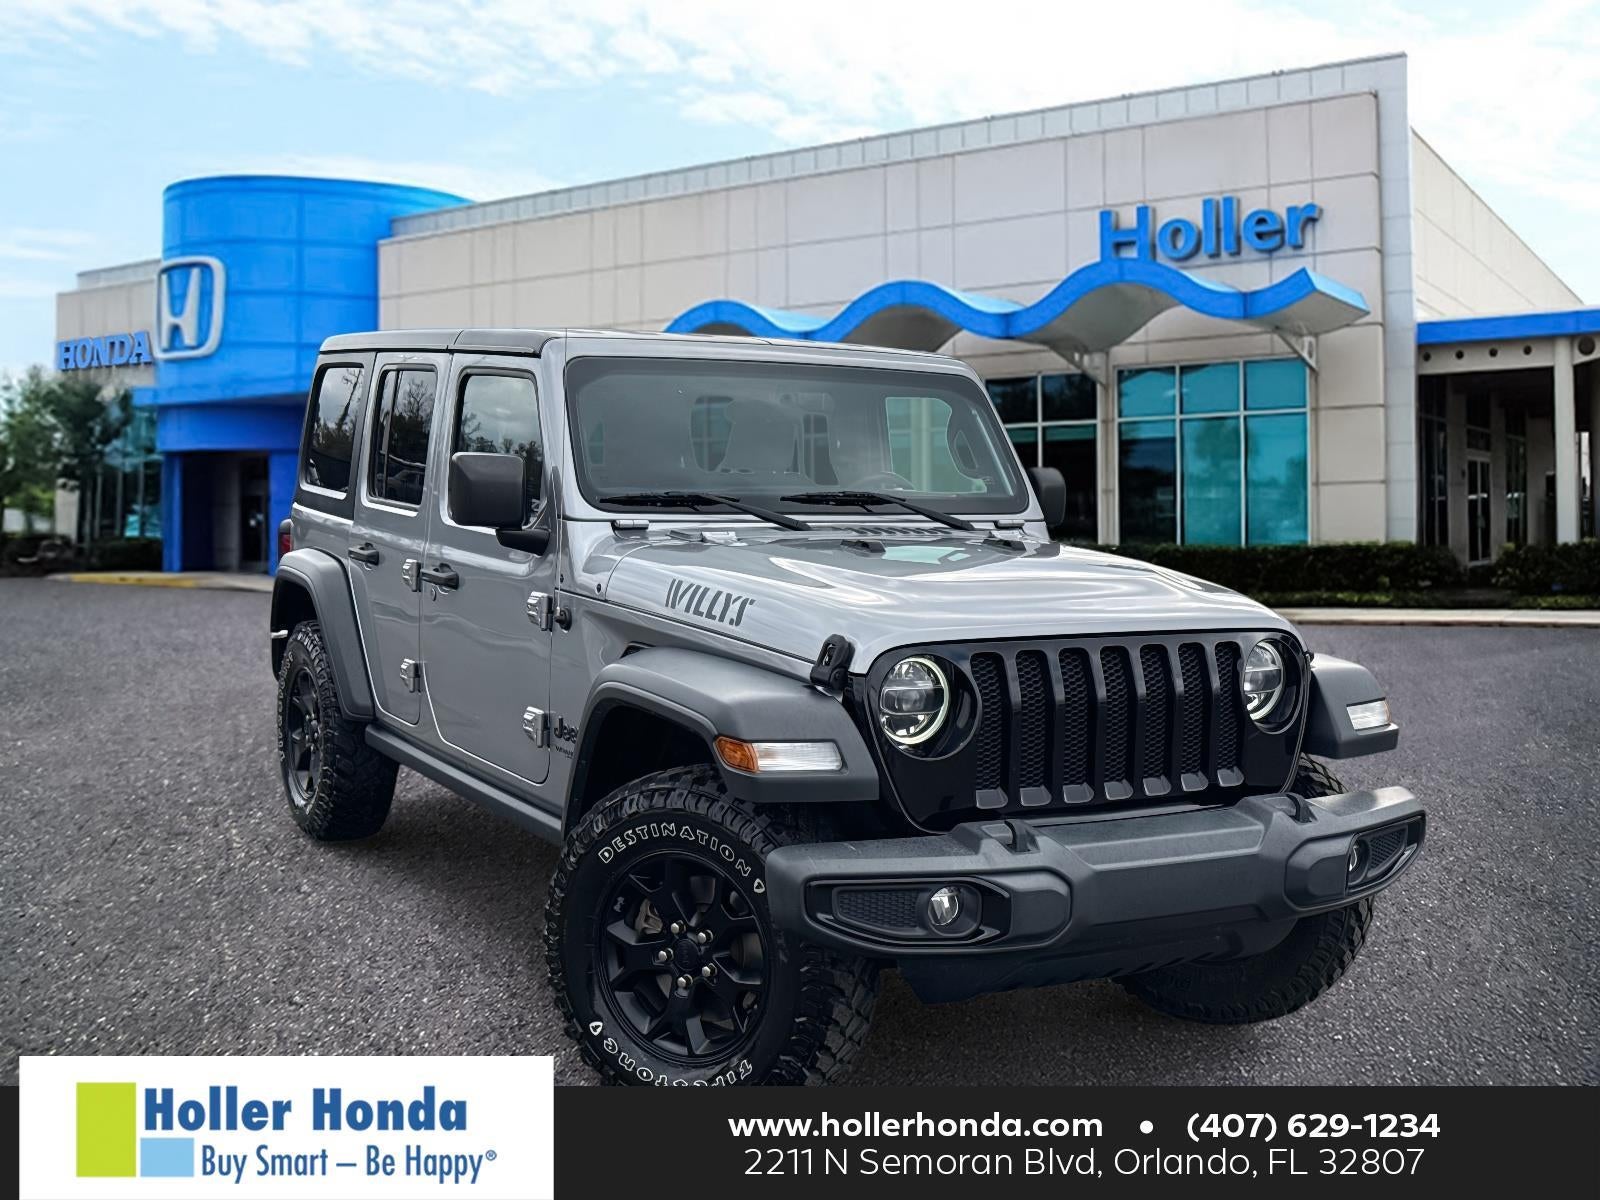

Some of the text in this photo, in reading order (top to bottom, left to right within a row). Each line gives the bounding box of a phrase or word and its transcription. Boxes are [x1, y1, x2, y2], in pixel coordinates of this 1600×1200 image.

[1099, 196, 1321, 262] Holler
[57, 331, 152, 370] HONDA
[664, 578, 757, 627] WILLYS
[553, 716, 579, 745] Jee
[598, 822, 752, 877] DESTINATION
